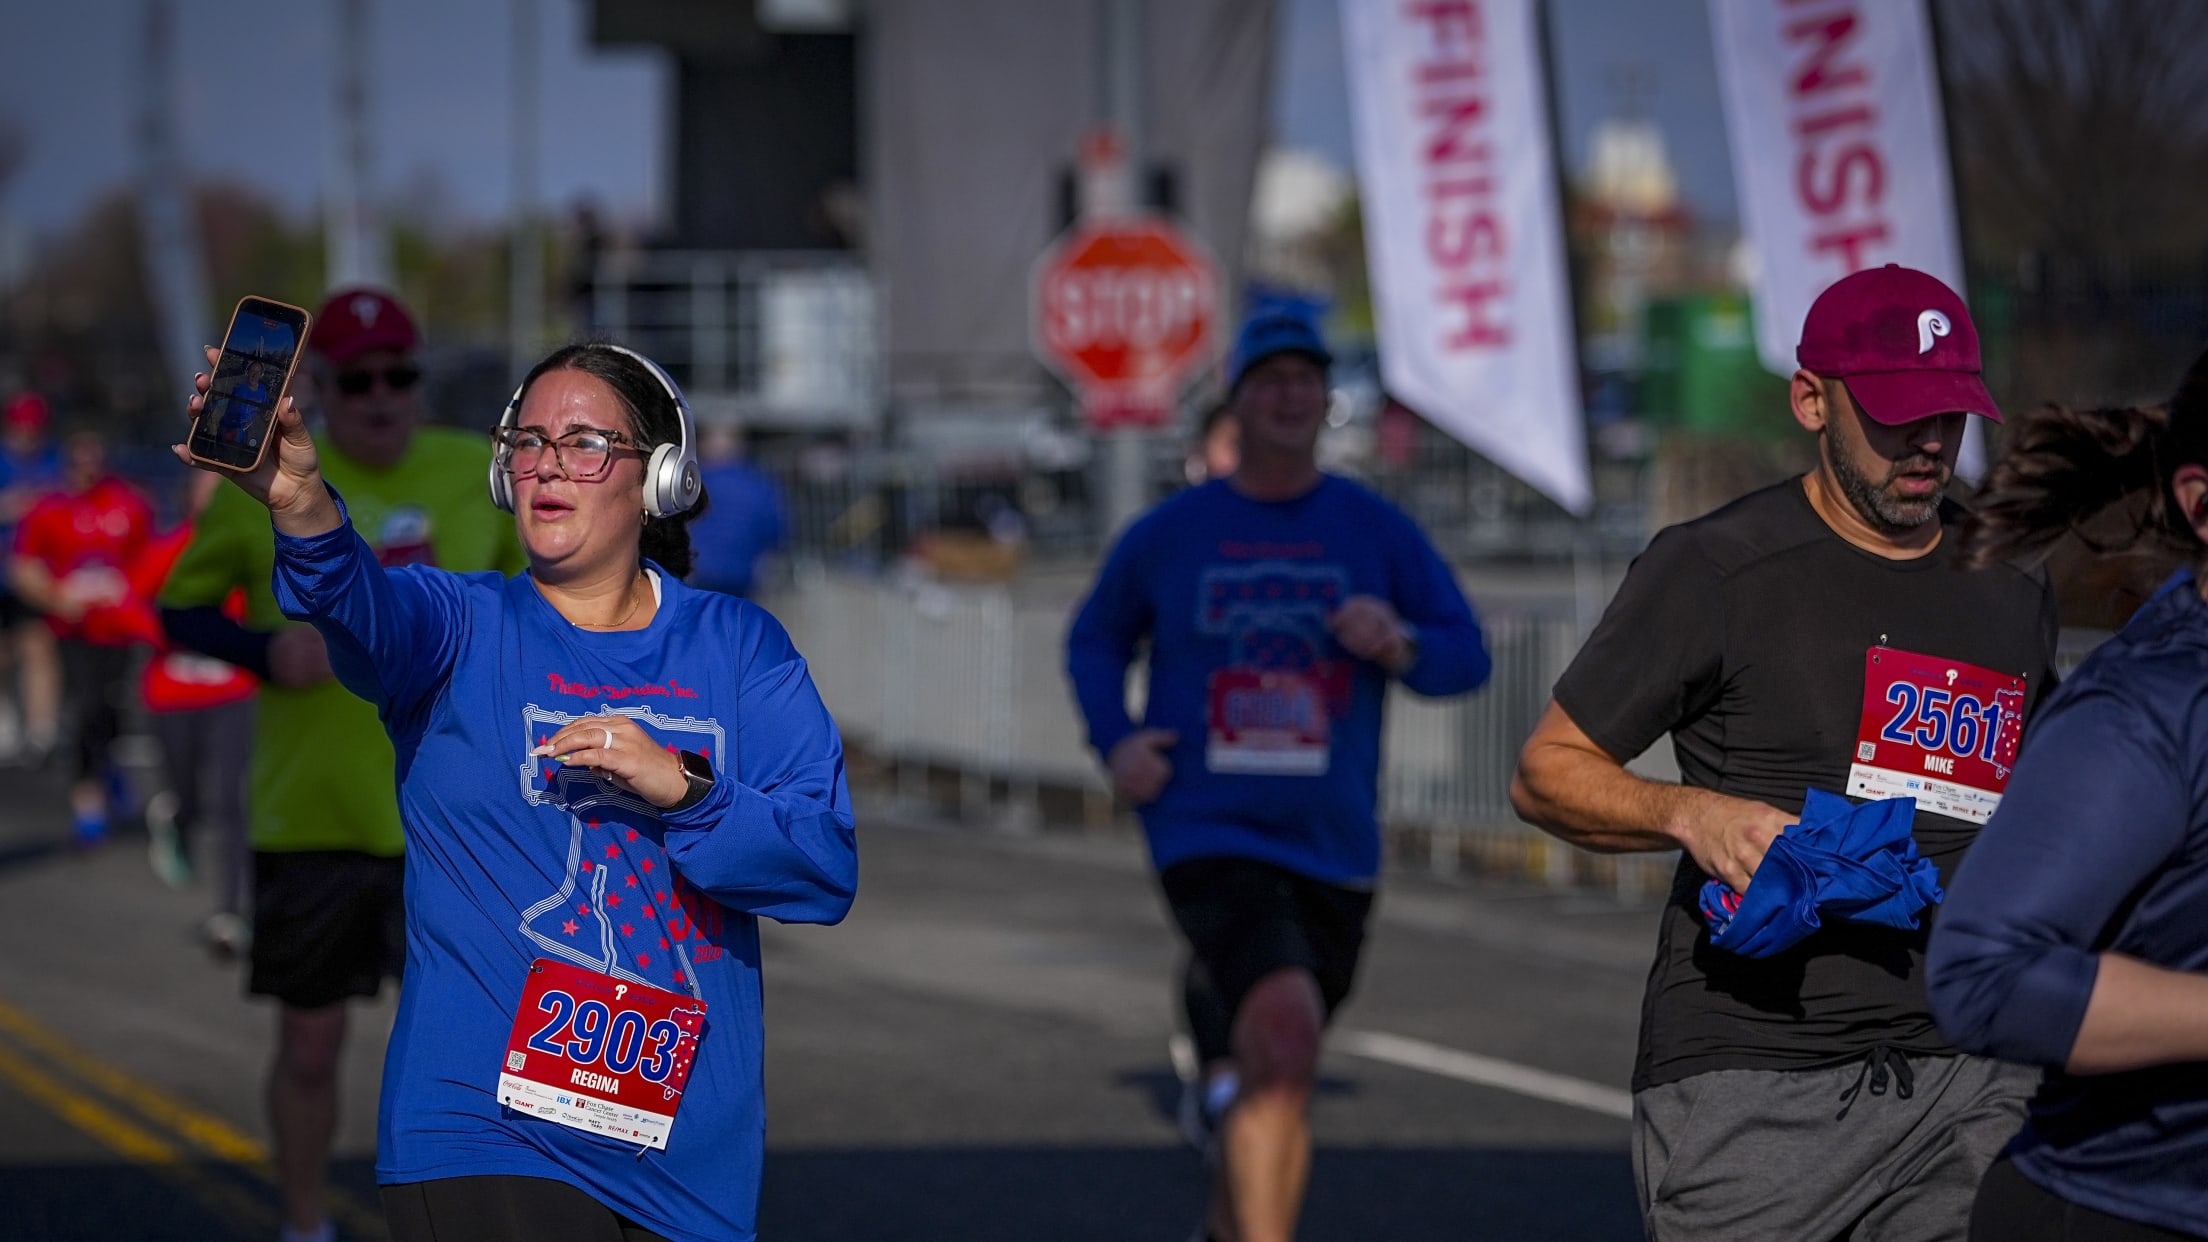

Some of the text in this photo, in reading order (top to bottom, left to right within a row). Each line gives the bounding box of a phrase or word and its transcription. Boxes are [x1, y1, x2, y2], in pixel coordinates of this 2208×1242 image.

[1404, 0, 1514, 354] FINISH
[1050, 268, 1206, 342] STOP
[1917, 309, 1951, 355] P
[669, 679, 699, 698] Inc.
[1881, 681, 2000, 762] 2561
[1924, 754, 1954, 775] MIKE
[615, 984, 628, 1001] P
[527, 990, 681, 1083] 2903
[570, 1068, 620, 1095] REGINA
[514, 1099, 534, 1109] GIANT
[556, 1095, 572, 1105] IBX
[608, 1124, 629, 1134] RE/MAX
